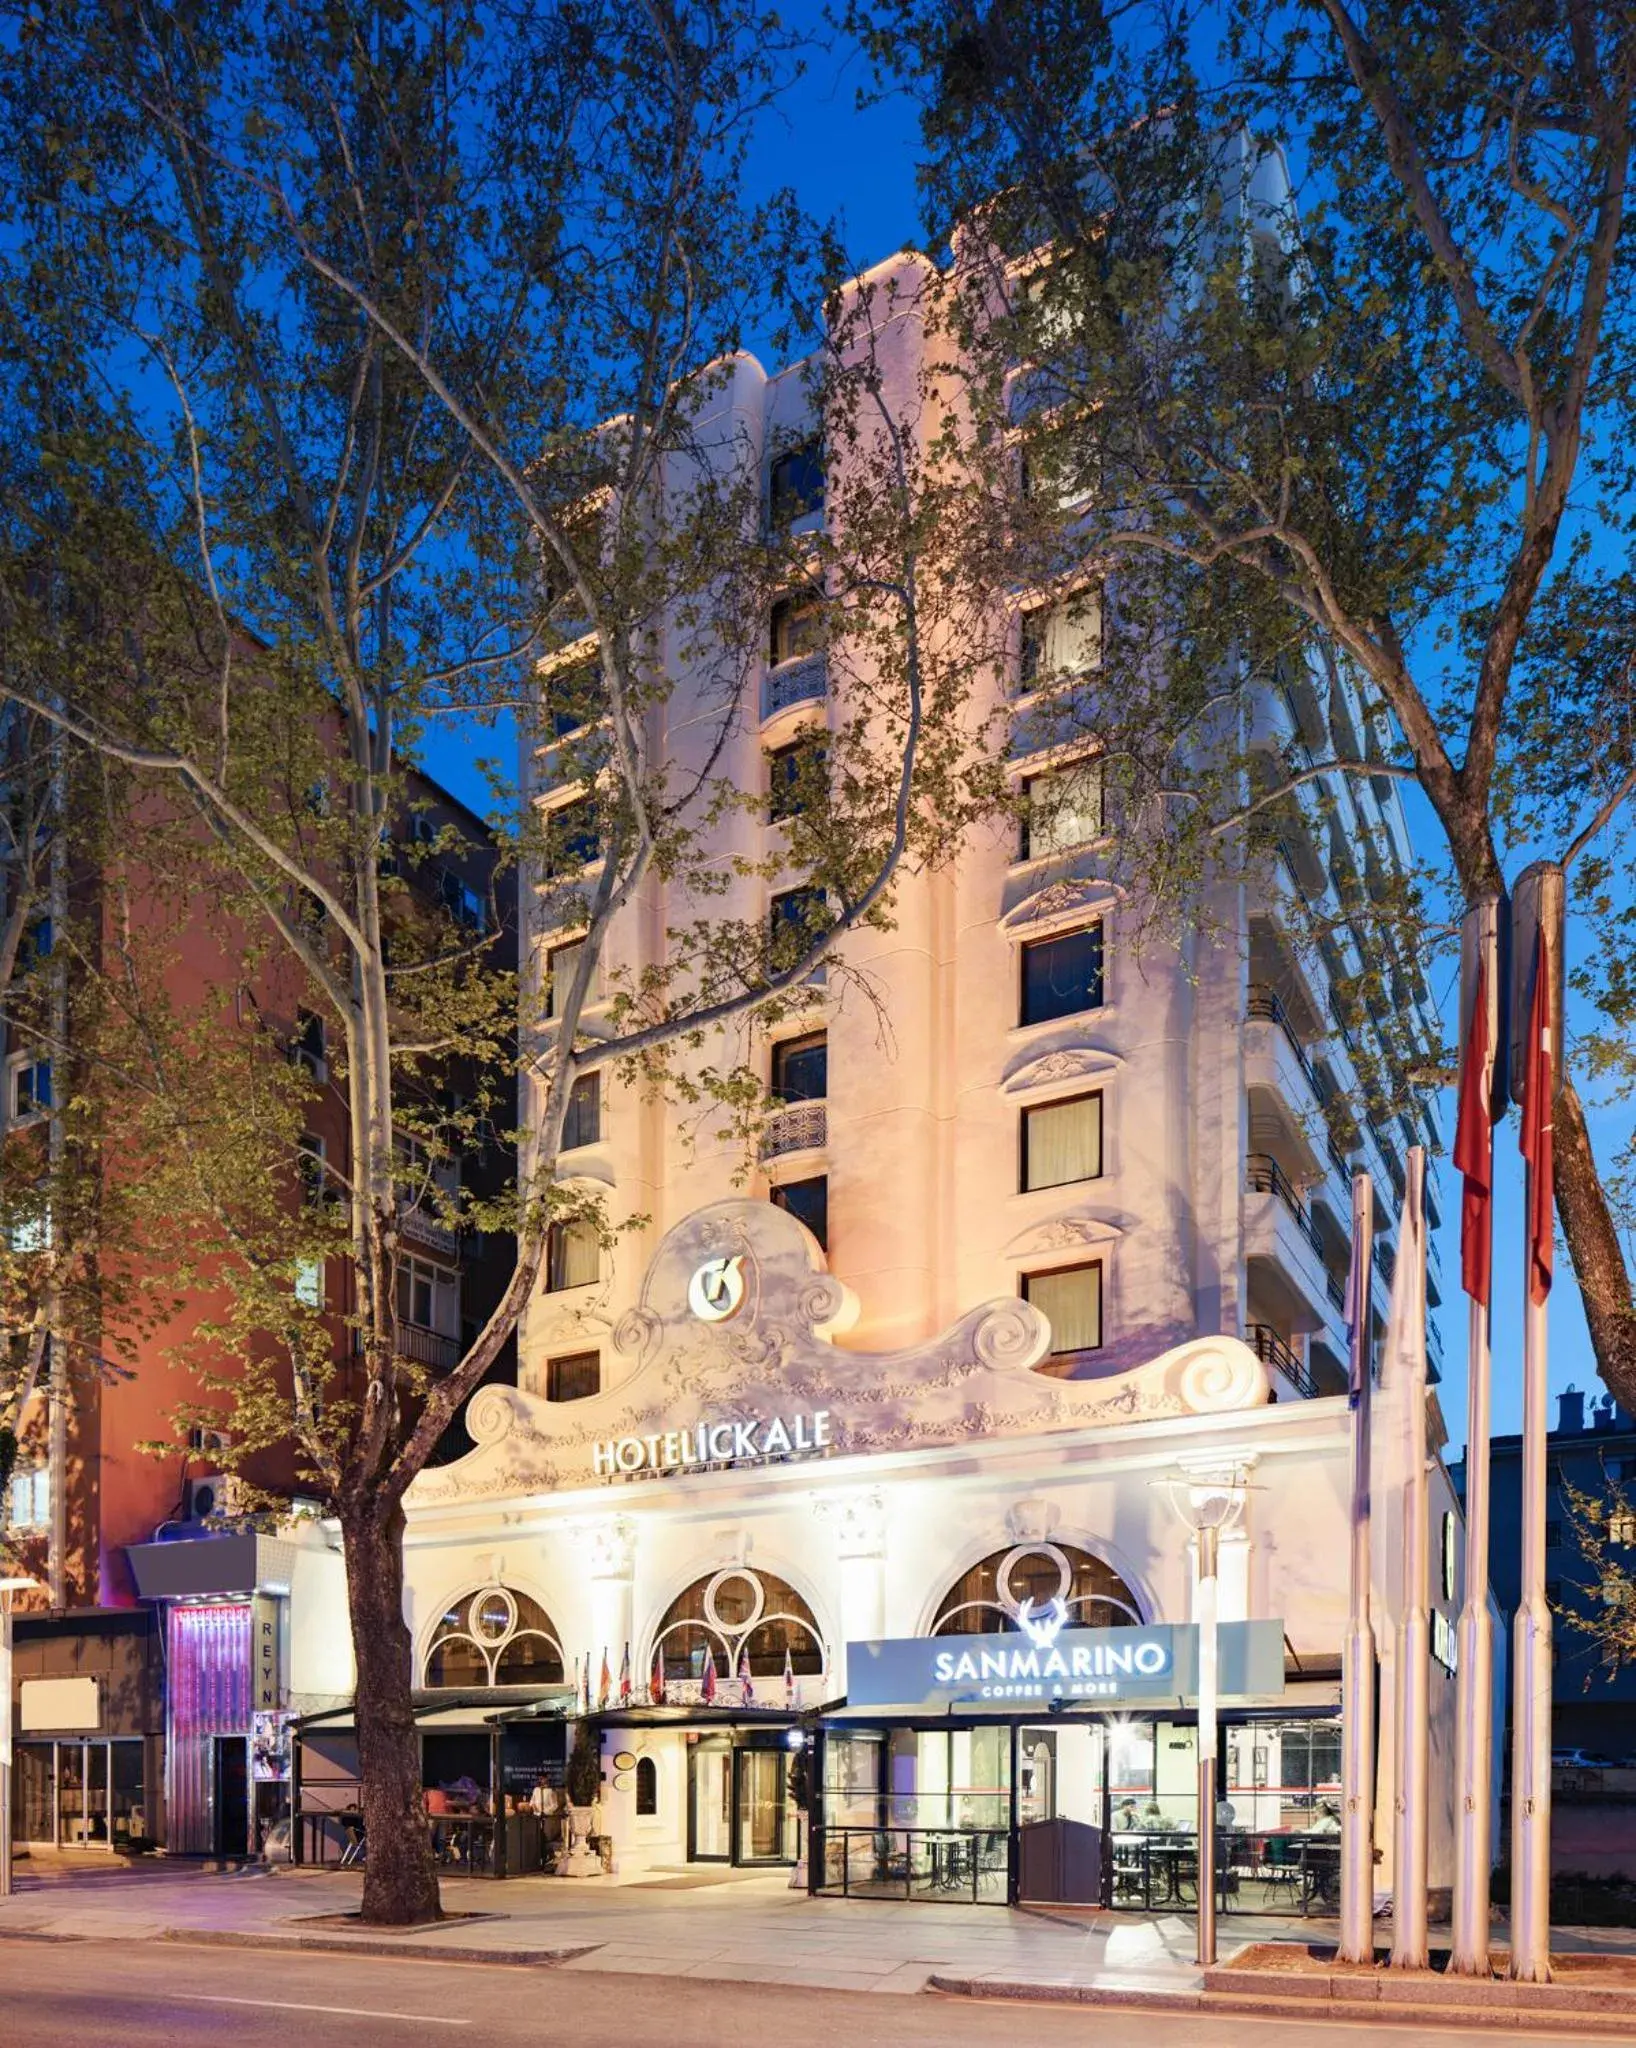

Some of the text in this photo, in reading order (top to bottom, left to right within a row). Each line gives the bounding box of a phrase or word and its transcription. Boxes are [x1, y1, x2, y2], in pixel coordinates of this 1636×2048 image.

[935, 1643, 1166, 1681] SANMARINO
[982, 1682, 1117, 1697] COFFEE & MORE
